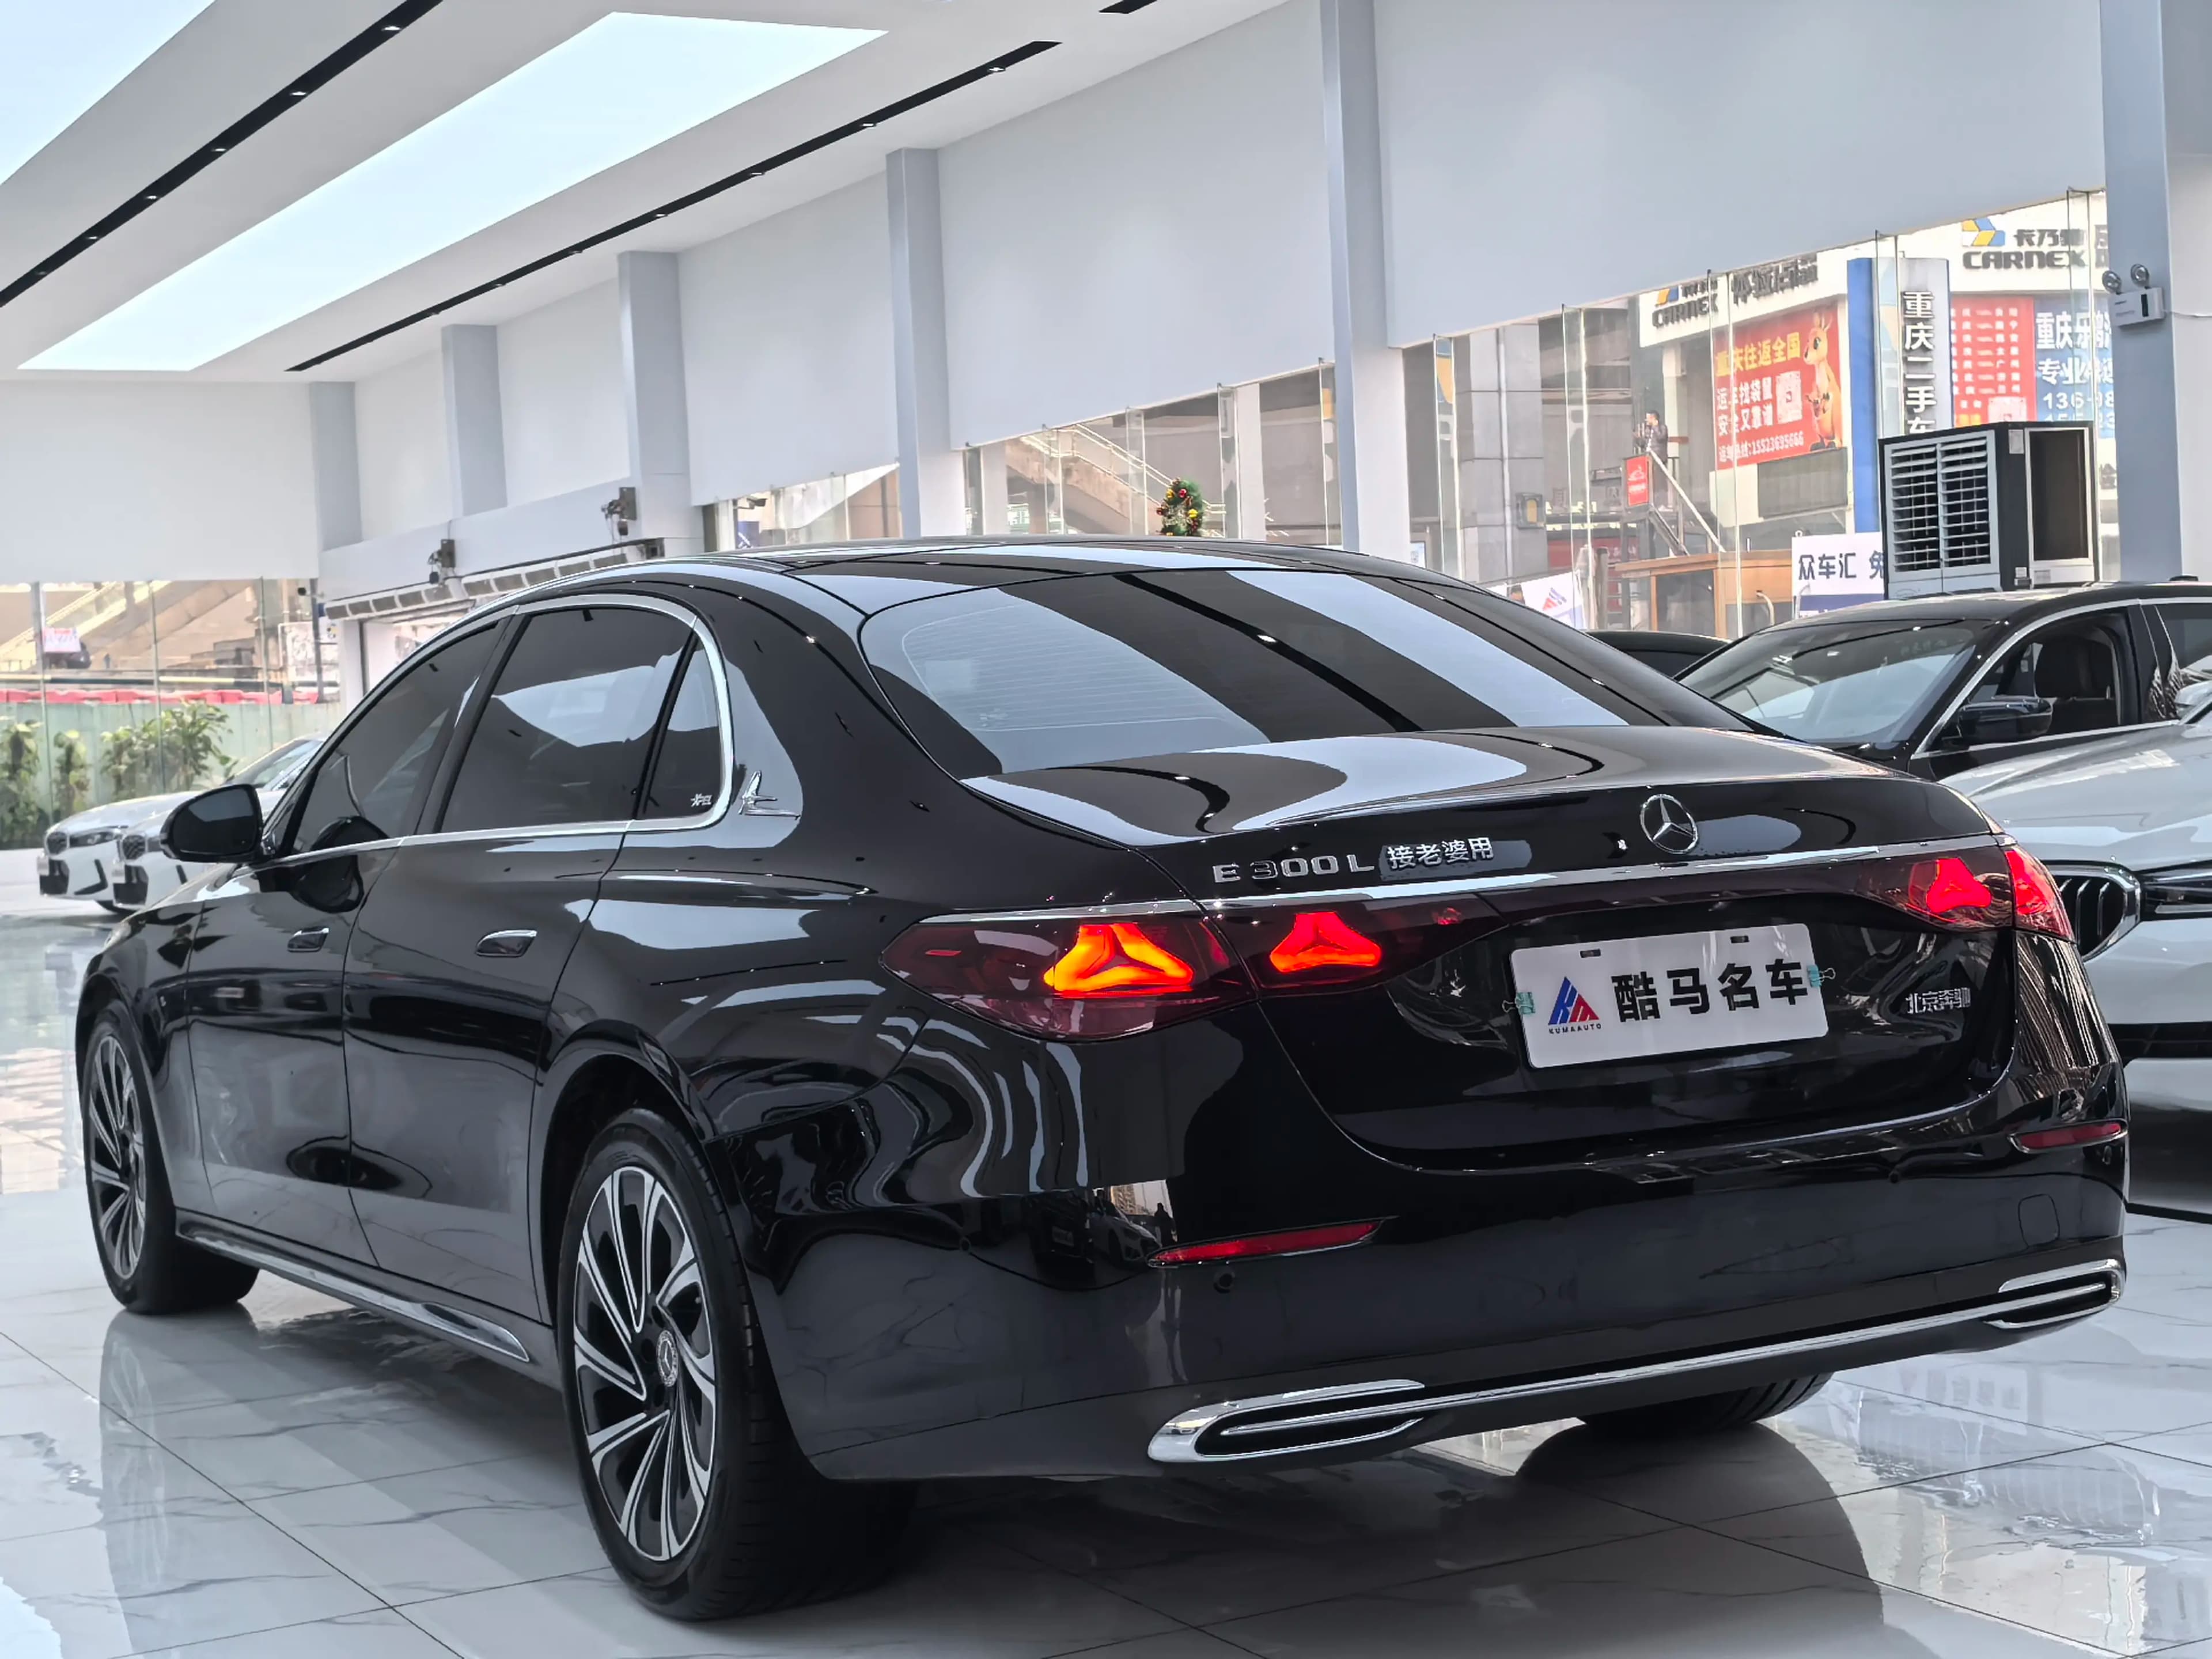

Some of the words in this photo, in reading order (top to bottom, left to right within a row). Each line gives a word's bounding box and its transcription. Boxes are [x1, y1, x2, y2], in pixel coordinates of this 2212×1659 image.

[1963, 250, 2087, 270] CARNEX
[1903, 291, 1937, 434] 重庆二手车
[1798, 553, 1857, 581] 众车汇
[1212, 863, 1241, 883] E
[1250, 855, 1340, 880] 300
[1346, 854, 1375, 873] L
[1386, 836, 1494, 870] 接老婆用
[1611, 958, 1808, 1022] 酷马名车
